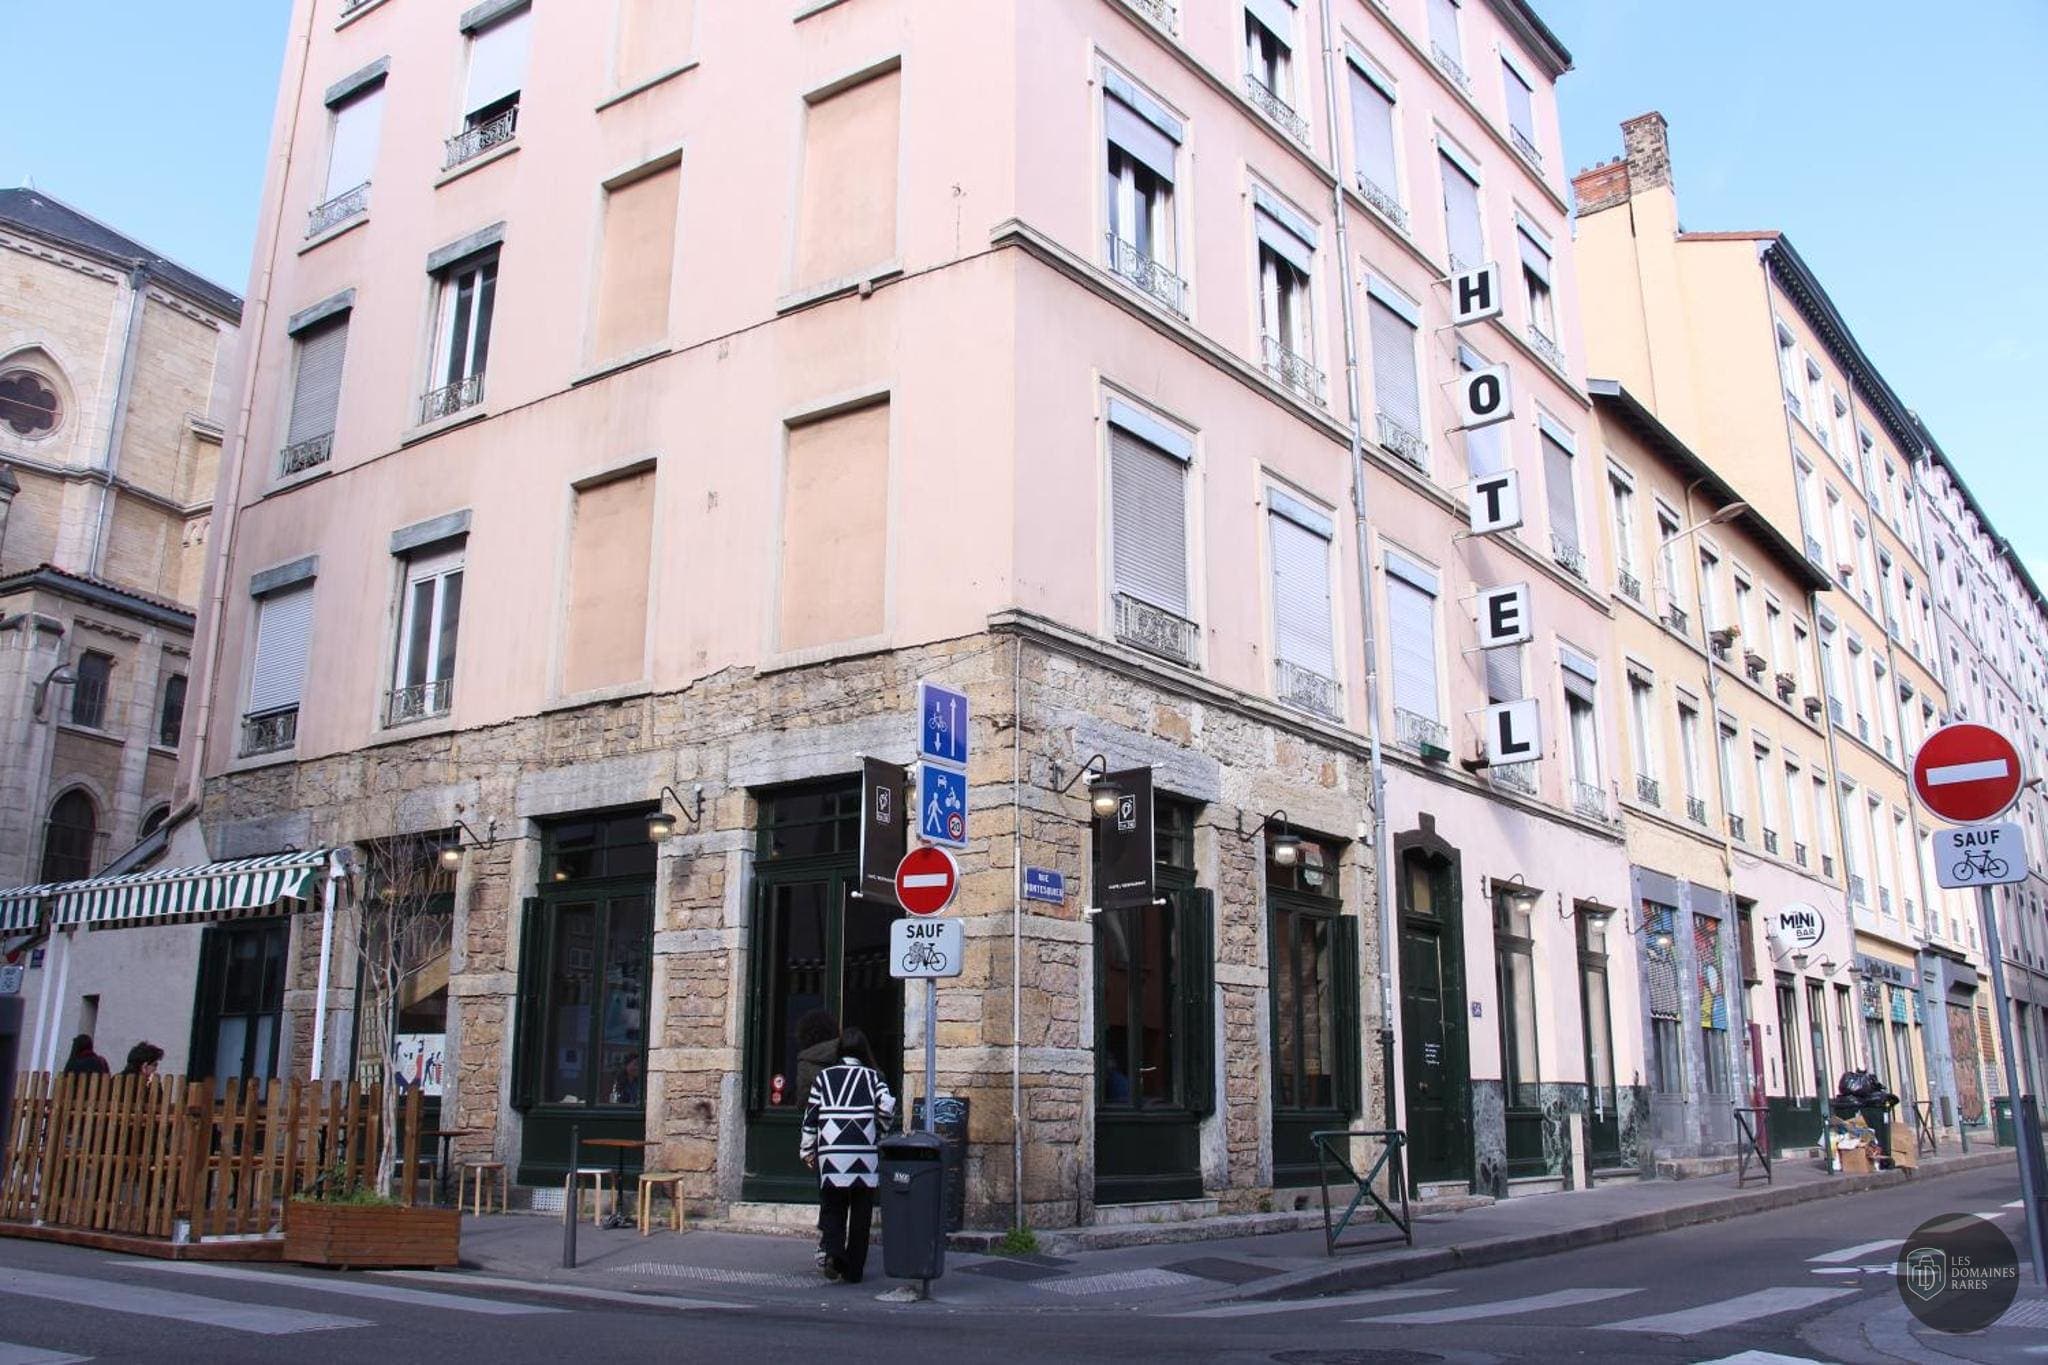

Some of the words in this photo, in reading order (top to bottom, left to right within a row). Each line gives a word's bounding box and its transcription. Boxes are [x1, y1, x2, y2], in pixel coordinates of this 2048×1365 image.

[1459, 270, 1530, 755] HOTEL
[951, 821, 960, 832] 20
[1953, 830, 2000, 848] SAUF
[1038, 873, 1049, 883] RUE
[1780, 911, 1815, 930] MINI
[906, 924, 945, 938] SAUF
[1796, 928, 1815, 937] BAR
